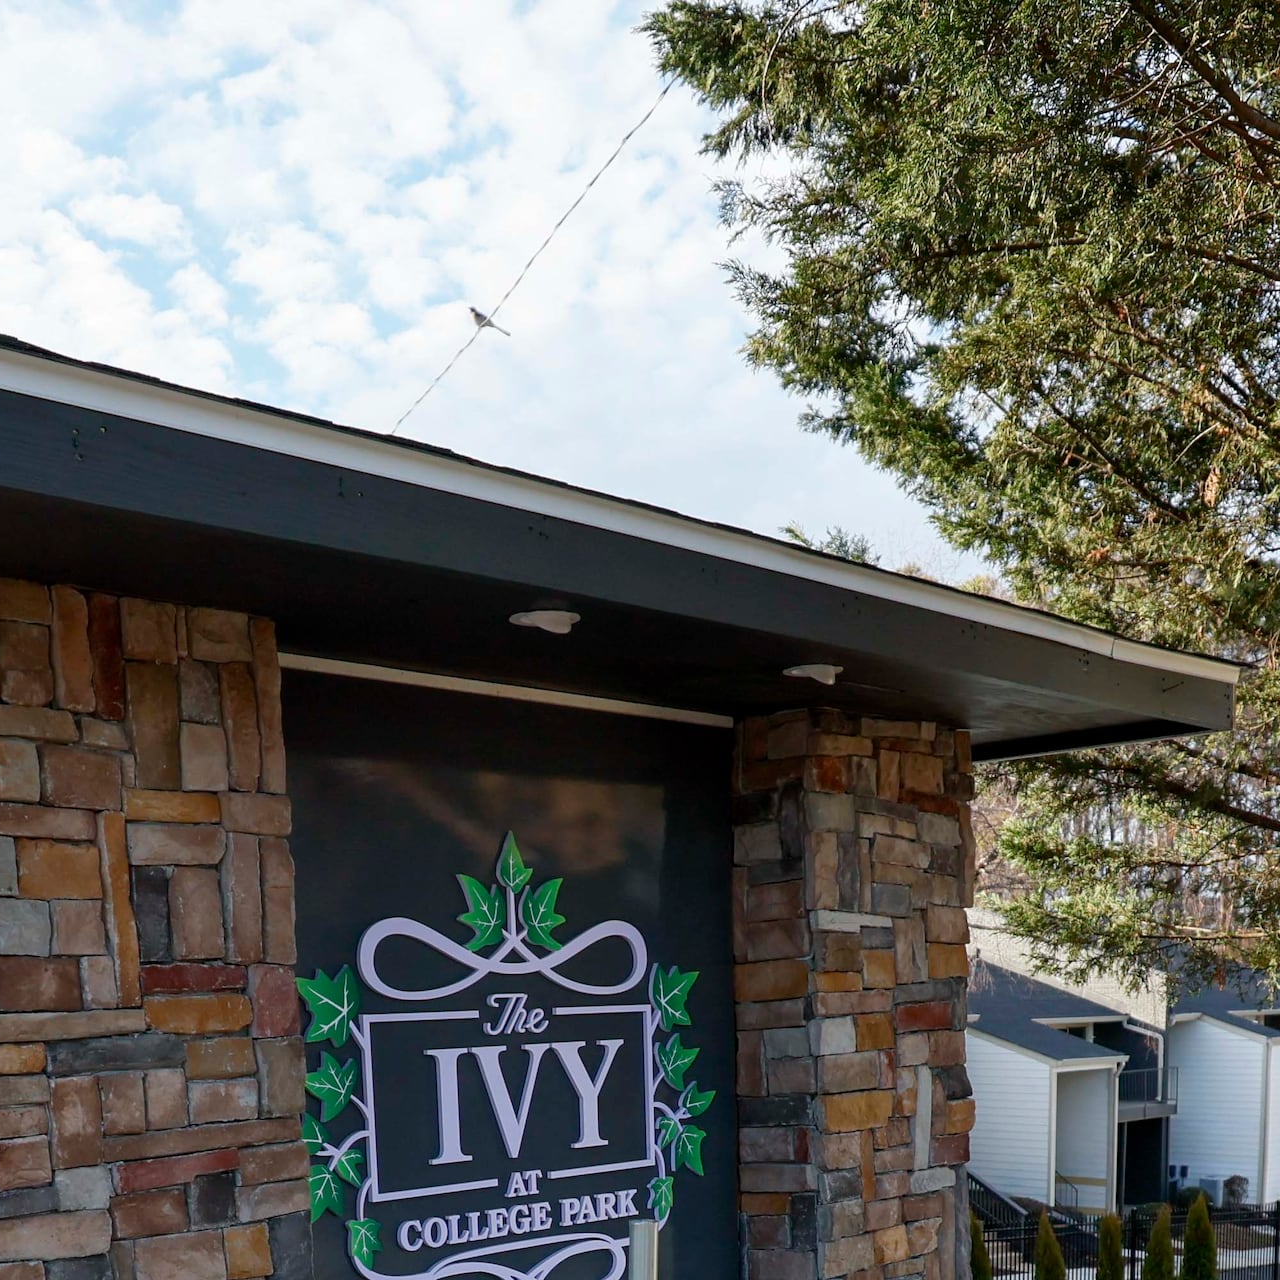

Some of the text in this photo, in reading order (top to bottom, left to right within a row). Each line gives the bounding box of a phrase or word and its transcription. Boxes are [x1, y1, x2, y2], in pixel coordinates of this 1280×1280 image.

[483, 993, 549, 1035] The
[423, 1039, 624, 1165] IVY
[504, 1169, 542, 1198] AT
[397, 1189, 639, 1252] COLLEGE PARK
